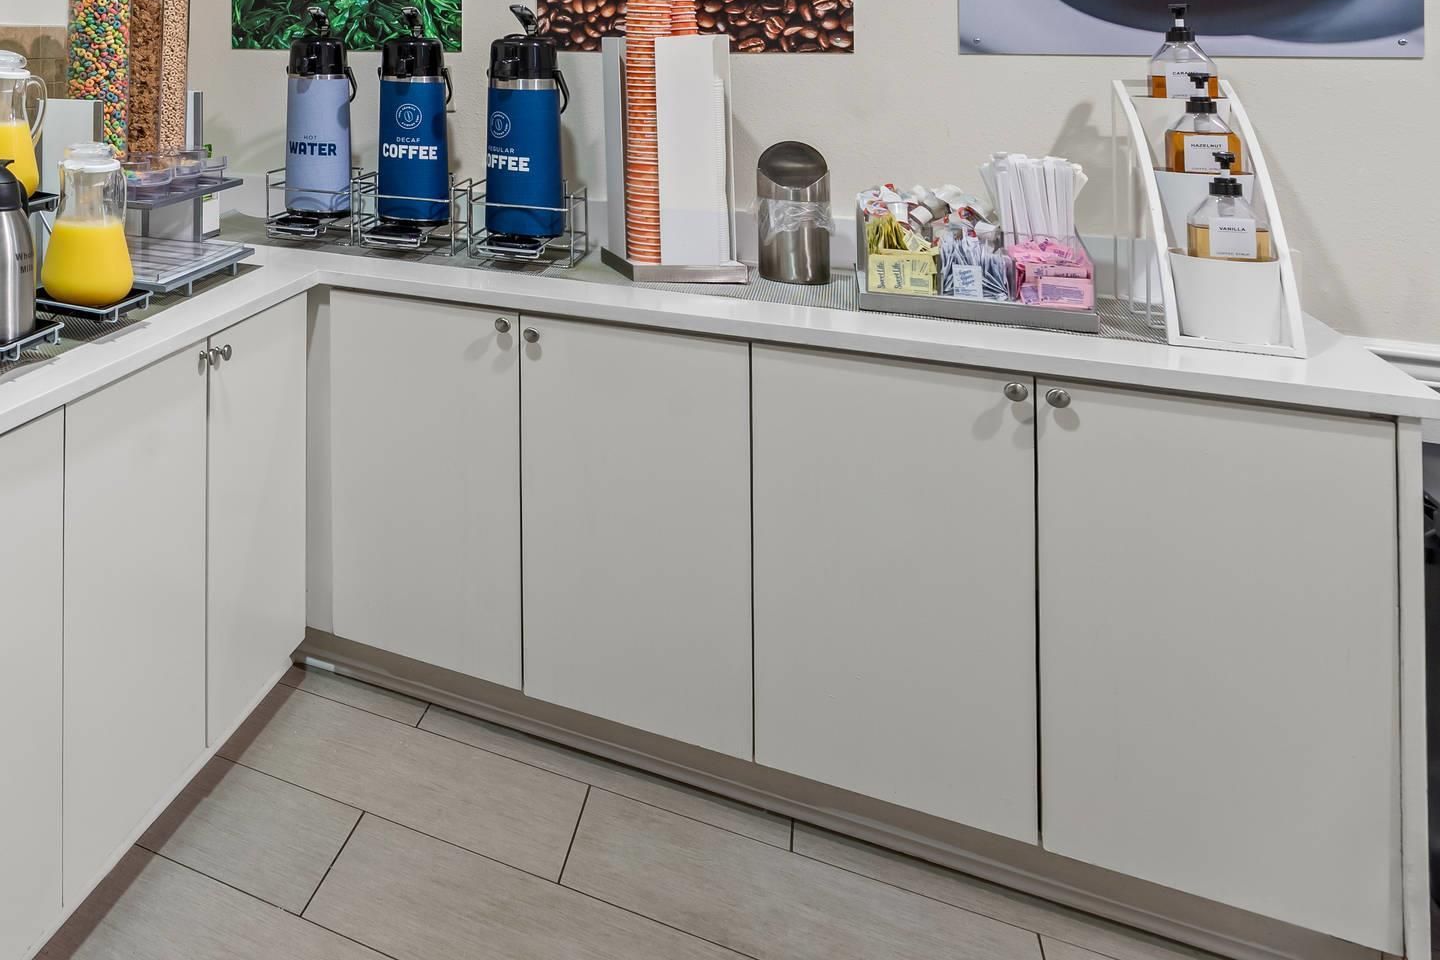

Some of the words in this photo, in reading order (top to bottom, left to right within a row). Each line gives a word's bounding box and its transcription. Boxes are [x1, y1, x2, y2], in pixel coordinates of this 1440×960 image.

[289, 141, 337, 156] WATER
[382, 143, 438, 160] COFFEE
[487, 153, 530, 172] OFFEE
